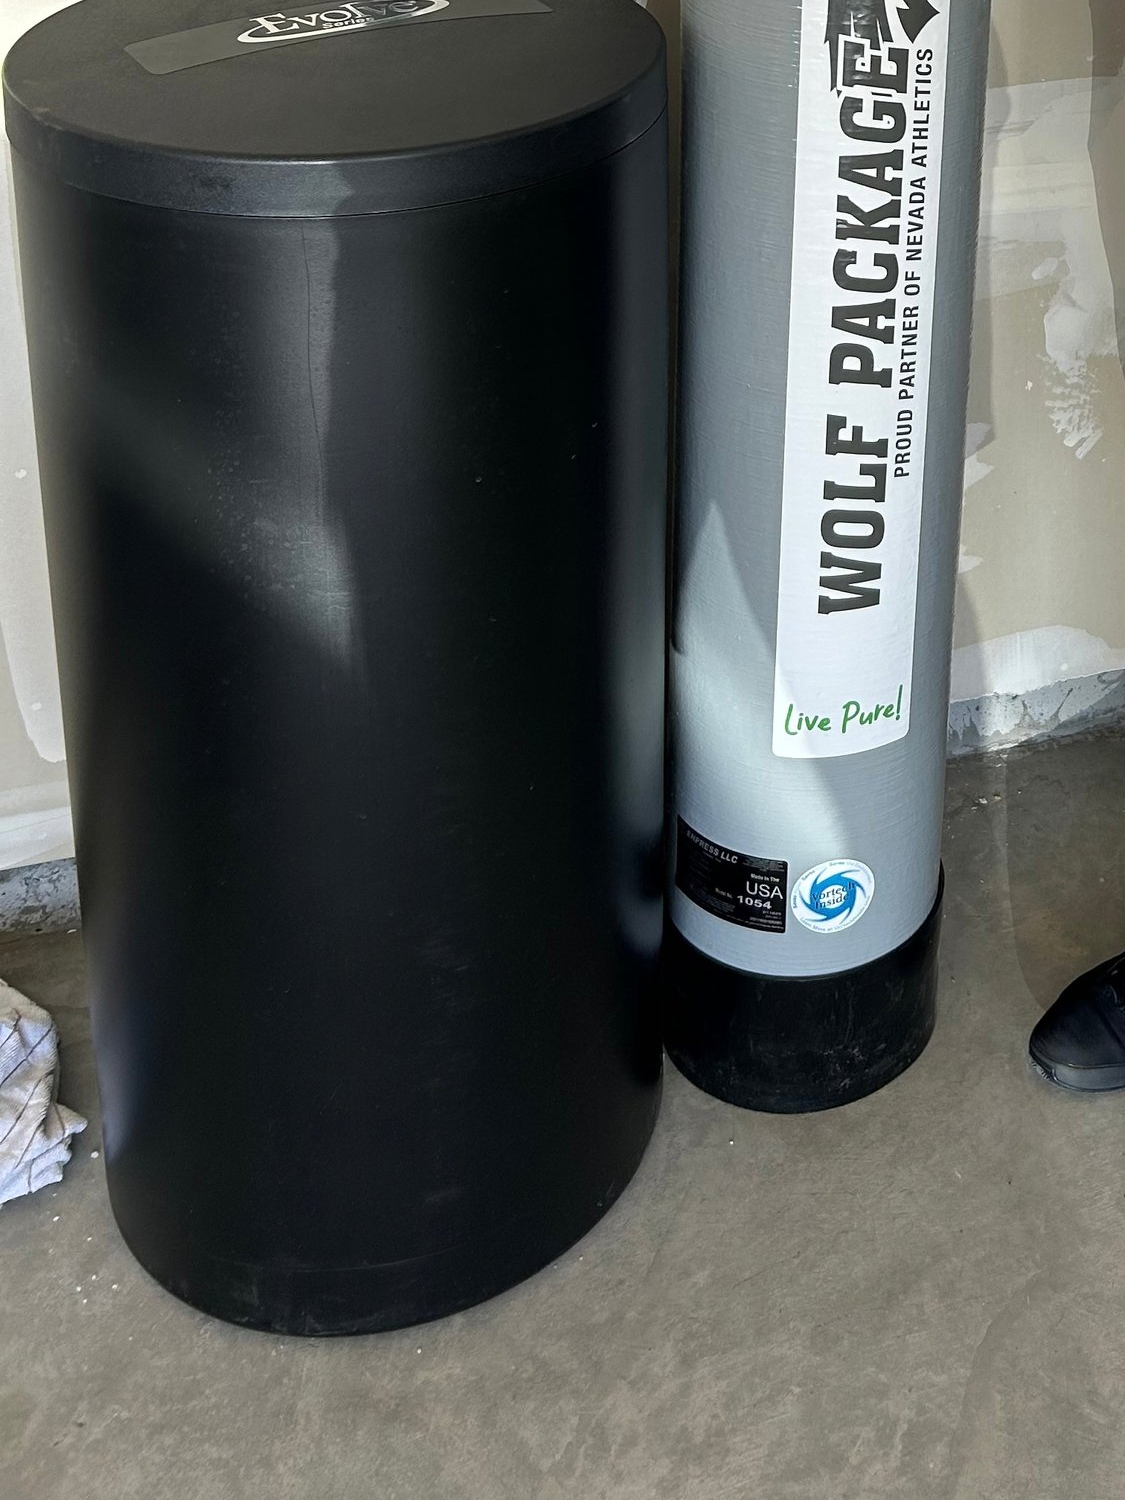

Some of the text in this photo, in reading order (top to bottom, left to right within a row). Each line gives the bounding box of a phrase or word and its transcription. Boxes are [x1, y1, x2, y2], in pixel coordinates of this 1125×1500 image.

[322, 15, 375, 30] Series
[894, 47, 934, 478] PROUD PARTNER OF NEVADA ATHLETICS
[818, 35, 910, 615] WOLF PACKAGE
[783, 684, 904, 736] Live Pure!
[721, 853, 738, 864] LLC
[746, 880, 783, 900] USA
[812, 882, 855, 901] Vortech
[737, 895, 772, 910] 1054
[815, 893, 848, 910] Inside
